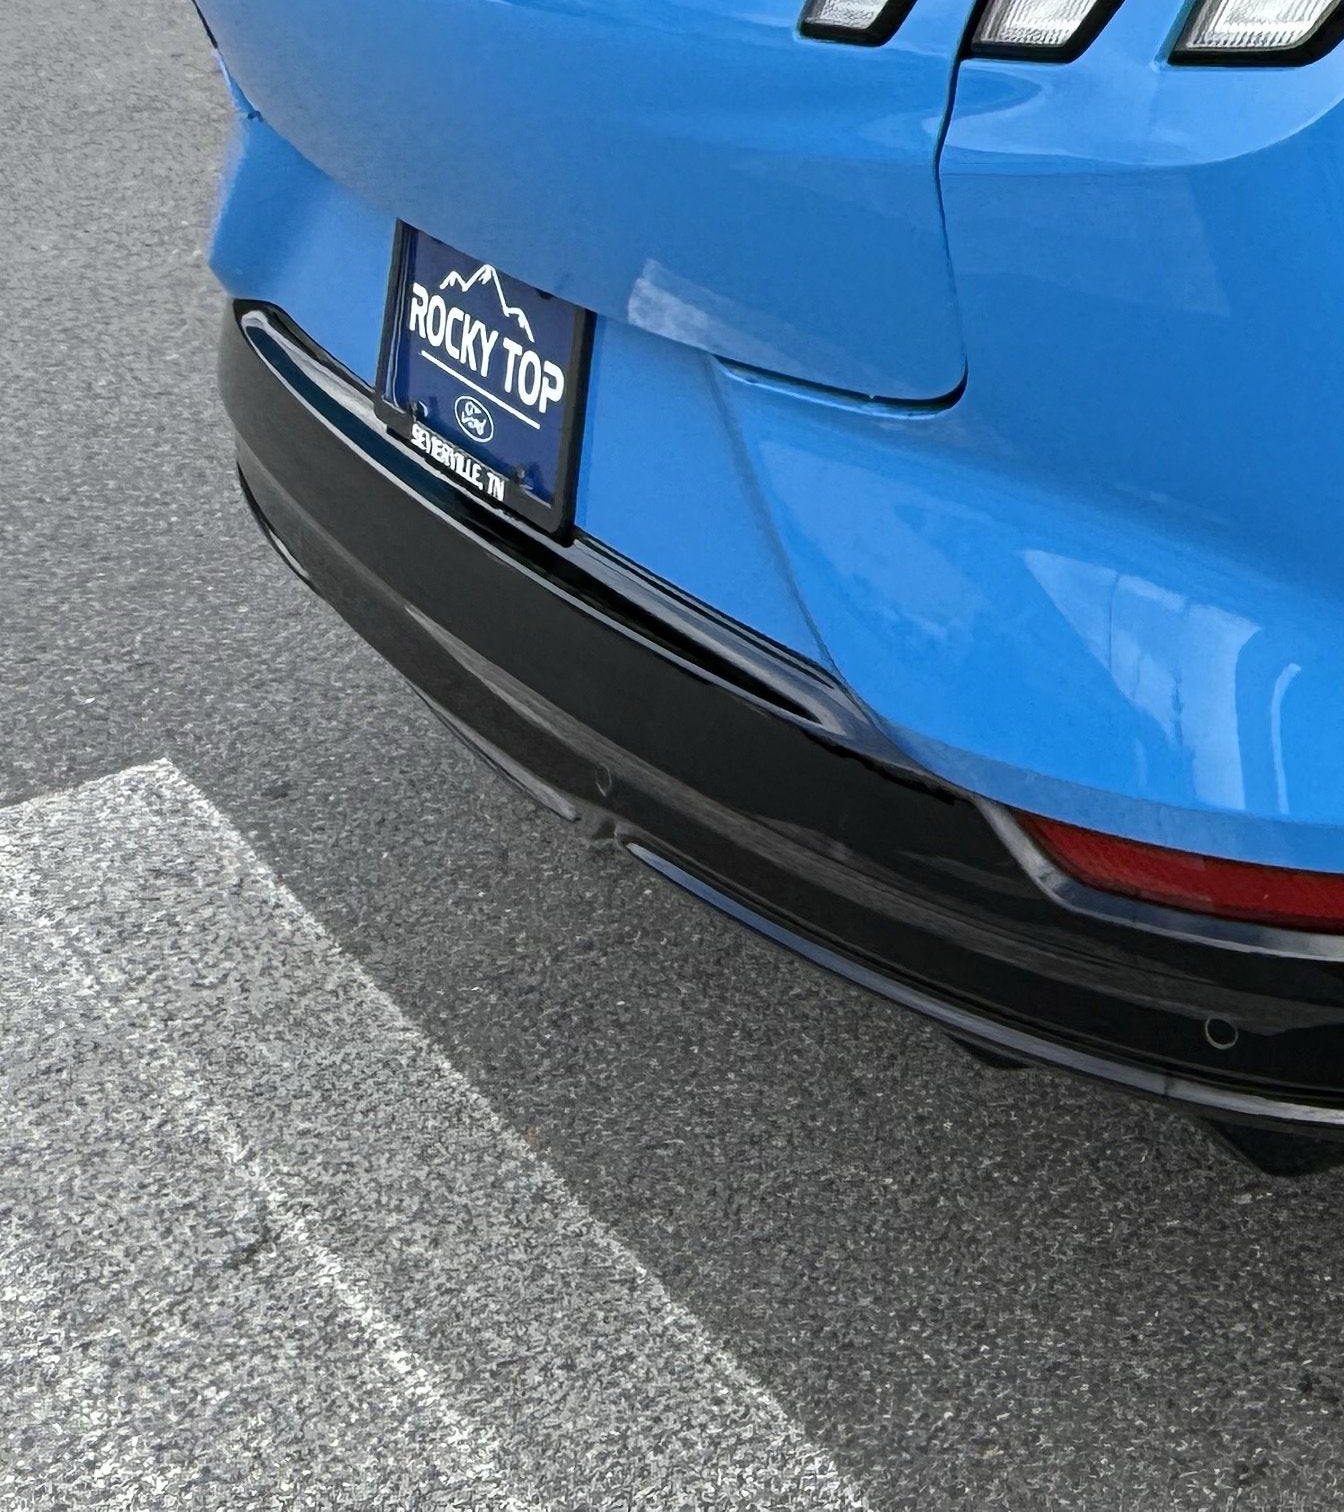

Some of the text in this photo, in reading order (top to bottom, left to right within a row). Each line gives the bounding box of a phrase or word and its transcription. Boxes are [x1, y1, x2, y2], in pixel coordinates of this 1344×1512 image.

[409, 282, 566, 414] ROCKY TOP
[487, 471, 506, 502] TN
